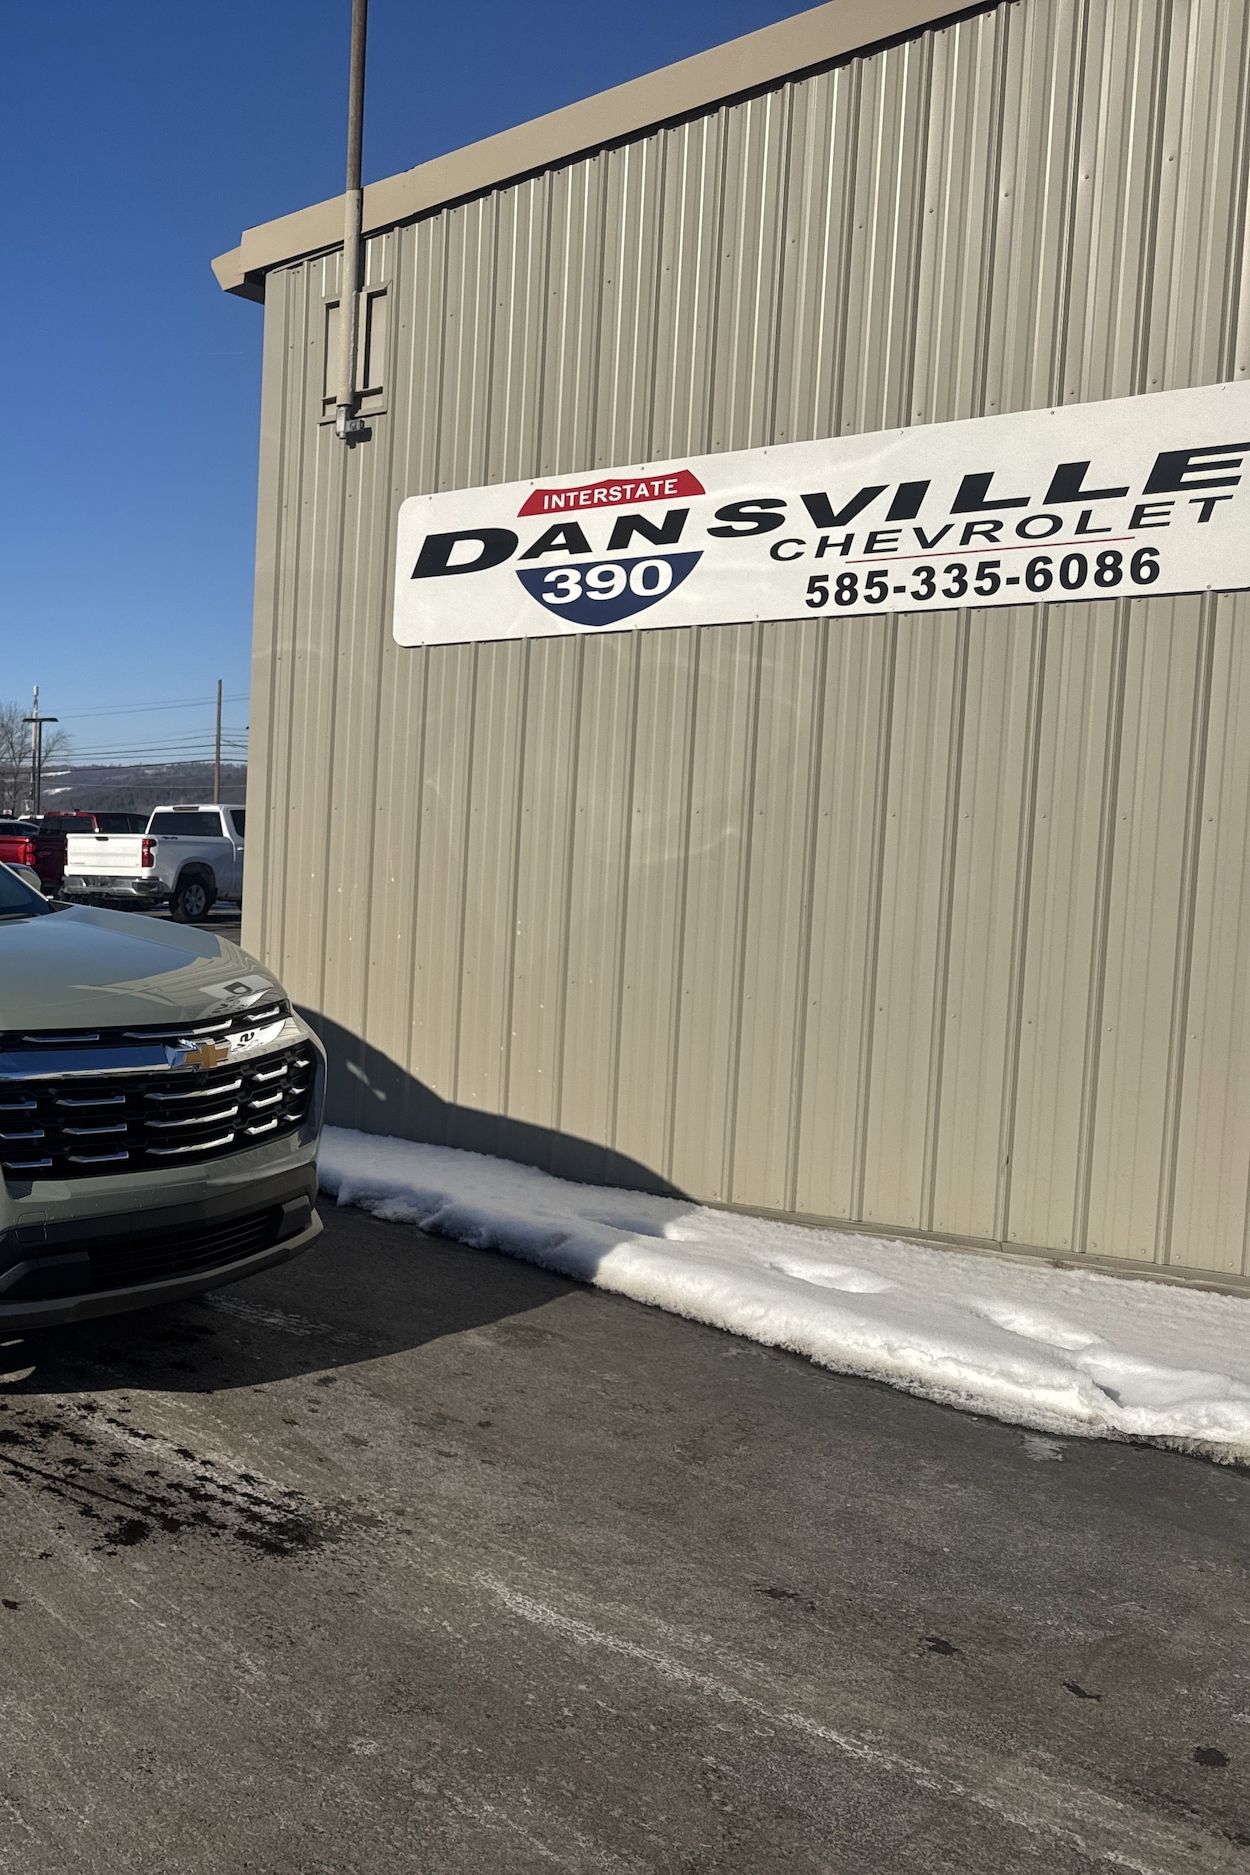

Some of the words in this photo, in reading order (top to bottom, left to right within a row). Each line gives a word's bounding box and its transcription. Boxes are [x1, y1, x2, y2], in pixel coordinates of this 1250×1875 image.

[410, 441, 1250, 580] DANSVILLE
[543, 478, 678, 510] INTERSTATE
[770, 494, 1234, 562] CHEVROLET
[541, 559, 673, 605] 390
[805, 546, 1161, 608] 585-335-6086
